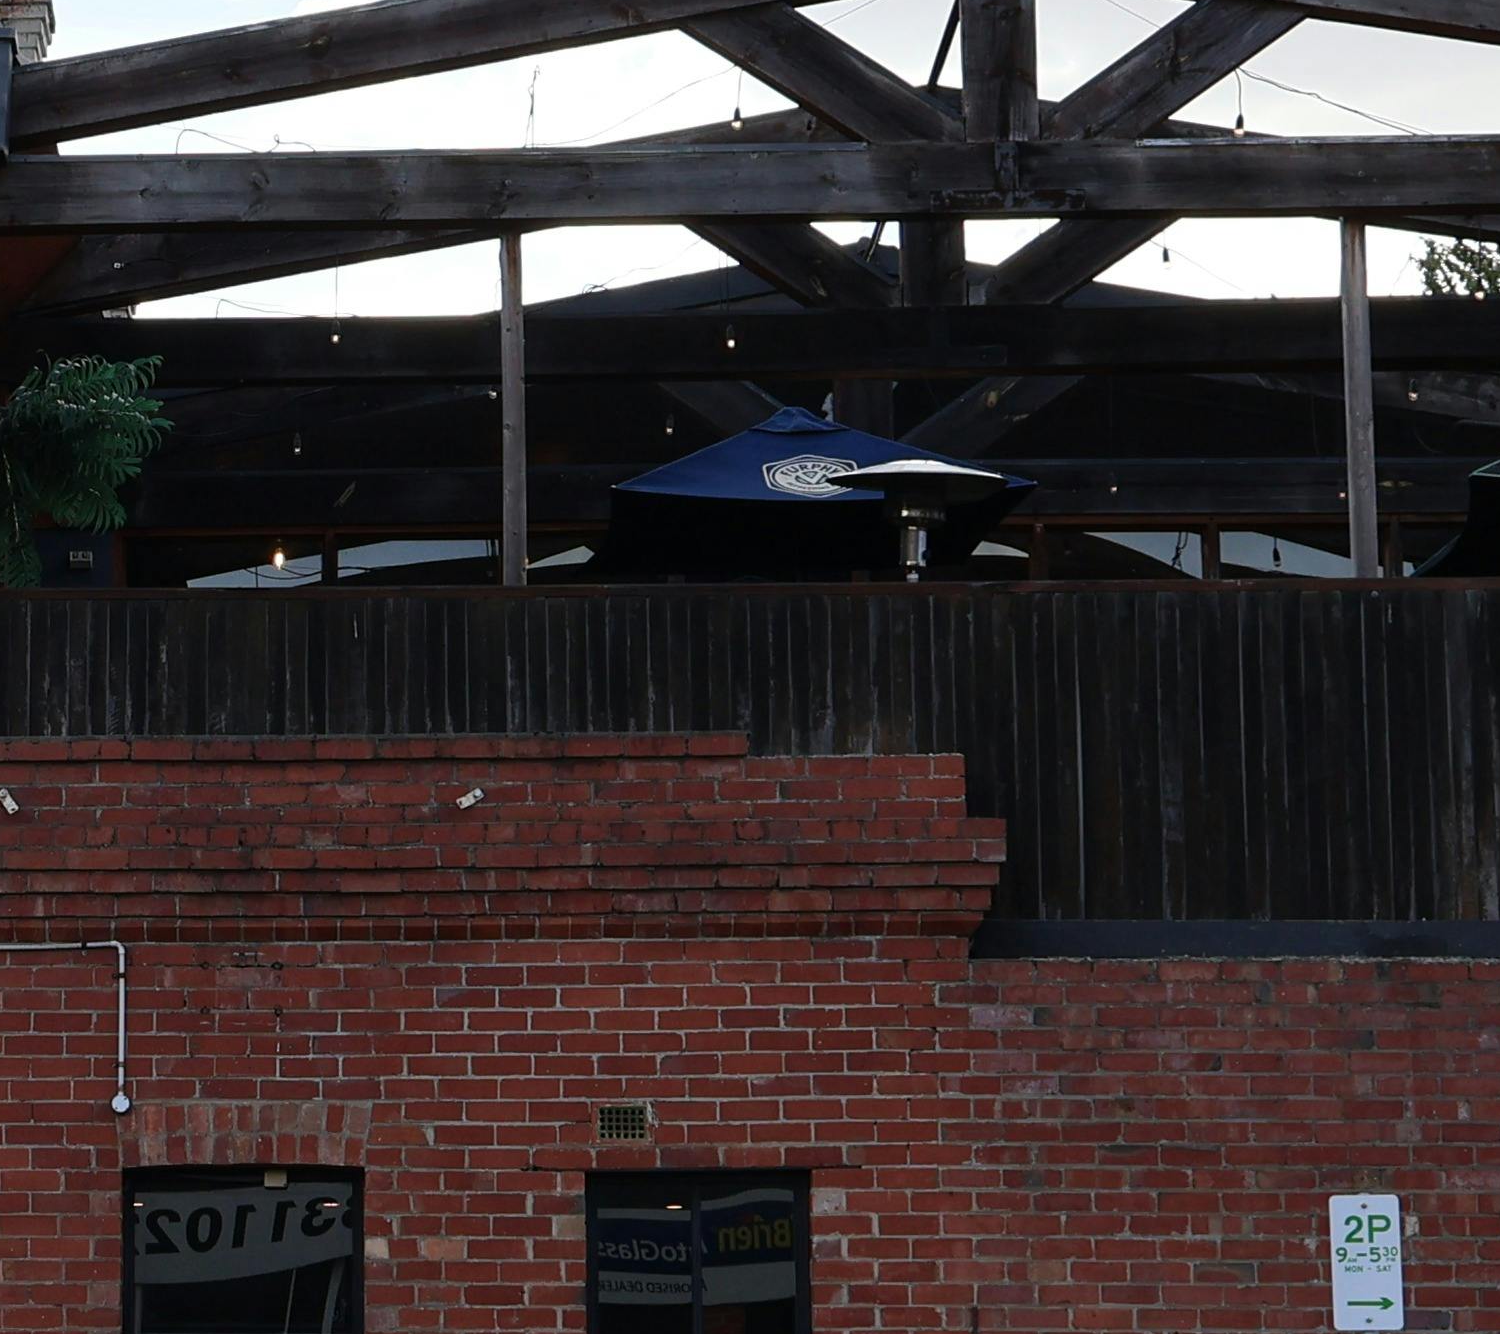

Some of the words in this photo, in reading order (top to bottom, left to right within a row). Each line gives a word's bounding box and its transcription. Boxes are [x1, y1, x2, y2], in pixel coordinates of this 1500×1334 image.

[1344, 1214, 1392, 1244] 2P
[1344, 1265, 1364, 1273] MON
[1376, 1265, 1392, 1273] SAT
